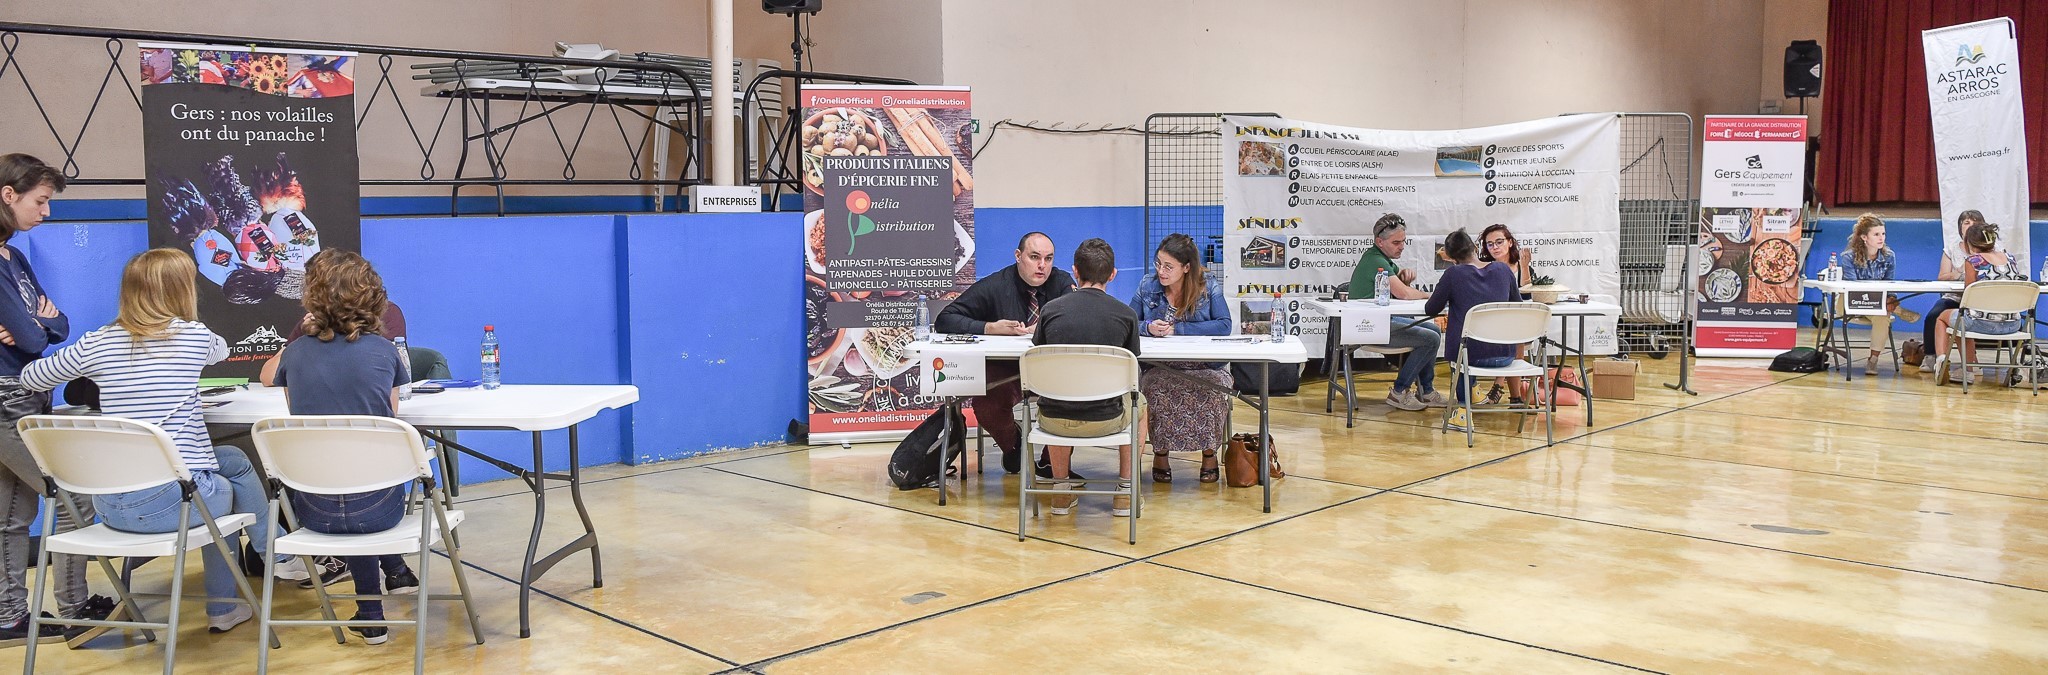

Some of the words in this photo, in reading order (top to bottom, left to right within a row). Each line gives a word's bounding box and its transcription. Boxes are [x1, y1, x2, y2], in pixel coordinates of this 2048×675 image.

[1937, 63, 2007, 84] ASTARAC
[1948, 77, 1999, 95] ARROS
[1960, 89, 2001, 101] GASCOGNE
[170, 103, 215, 121] Gers
[231, 109, 261, 122] nos
[266, 104, 334, 124] volailles
[180, 127, 212, 141] ont
[217, 126, 240, 141] du
[245, 126, 315, 145] panache
[1235, 126, 1296, 138] ENFANCE
[1326, 147, 1375, 156] PÉRISCOLAIRE
[1537, 144, 1565, 152] SPORTS
[1948, 147, 2010, 162] www.cdcaag.fr
[826, 158, 890, 170] PRODUITS
[893, 158, 950, 170] ITALIENS
[1324, 160, 1334, 168] DE
[1529, 156, 1557, 165] JEUNES
[1534, 169, 1540, 177] À
[1714, 168, 1741, 179] Gers
[838, 172, 908, 187] D'ÉPICERIE
[910, 175, 939, 186] FINE
[1314, 185, 1351, 193] D'ACCUEIL
[1532, 182, 1572, 190] ARTISTIQUE
[703, 197, 757, 206] ENTREPRISES
[1316, 198, 1346, 207] ACCUEIL
[1347, 198, 1384, 207] (CRÈCHES)
[1544, 195, 1579, 203] SCOLAIRE
[1239, 216, 1298, 229] SÉNIORS
[1534, 238, 1556, 246] SOINS
[1302, 247, 1345, 255] TEMPORAIRE
[1326, 260, 1350, 268] D'AIDE
[1560, 259, 1565, 267] À
[830, 270, 882, 279] TAPENADES
[889, 269, 916, 278] HUILE
[918, 269, 952, 278] D'OLIVE
[830, 280, 888, 289] LIMONCELLO
[897, 278, 953, 288] PÂTISSERIES
[256, 344, 278, 352] DES
[898, 393, 909, 407] à
